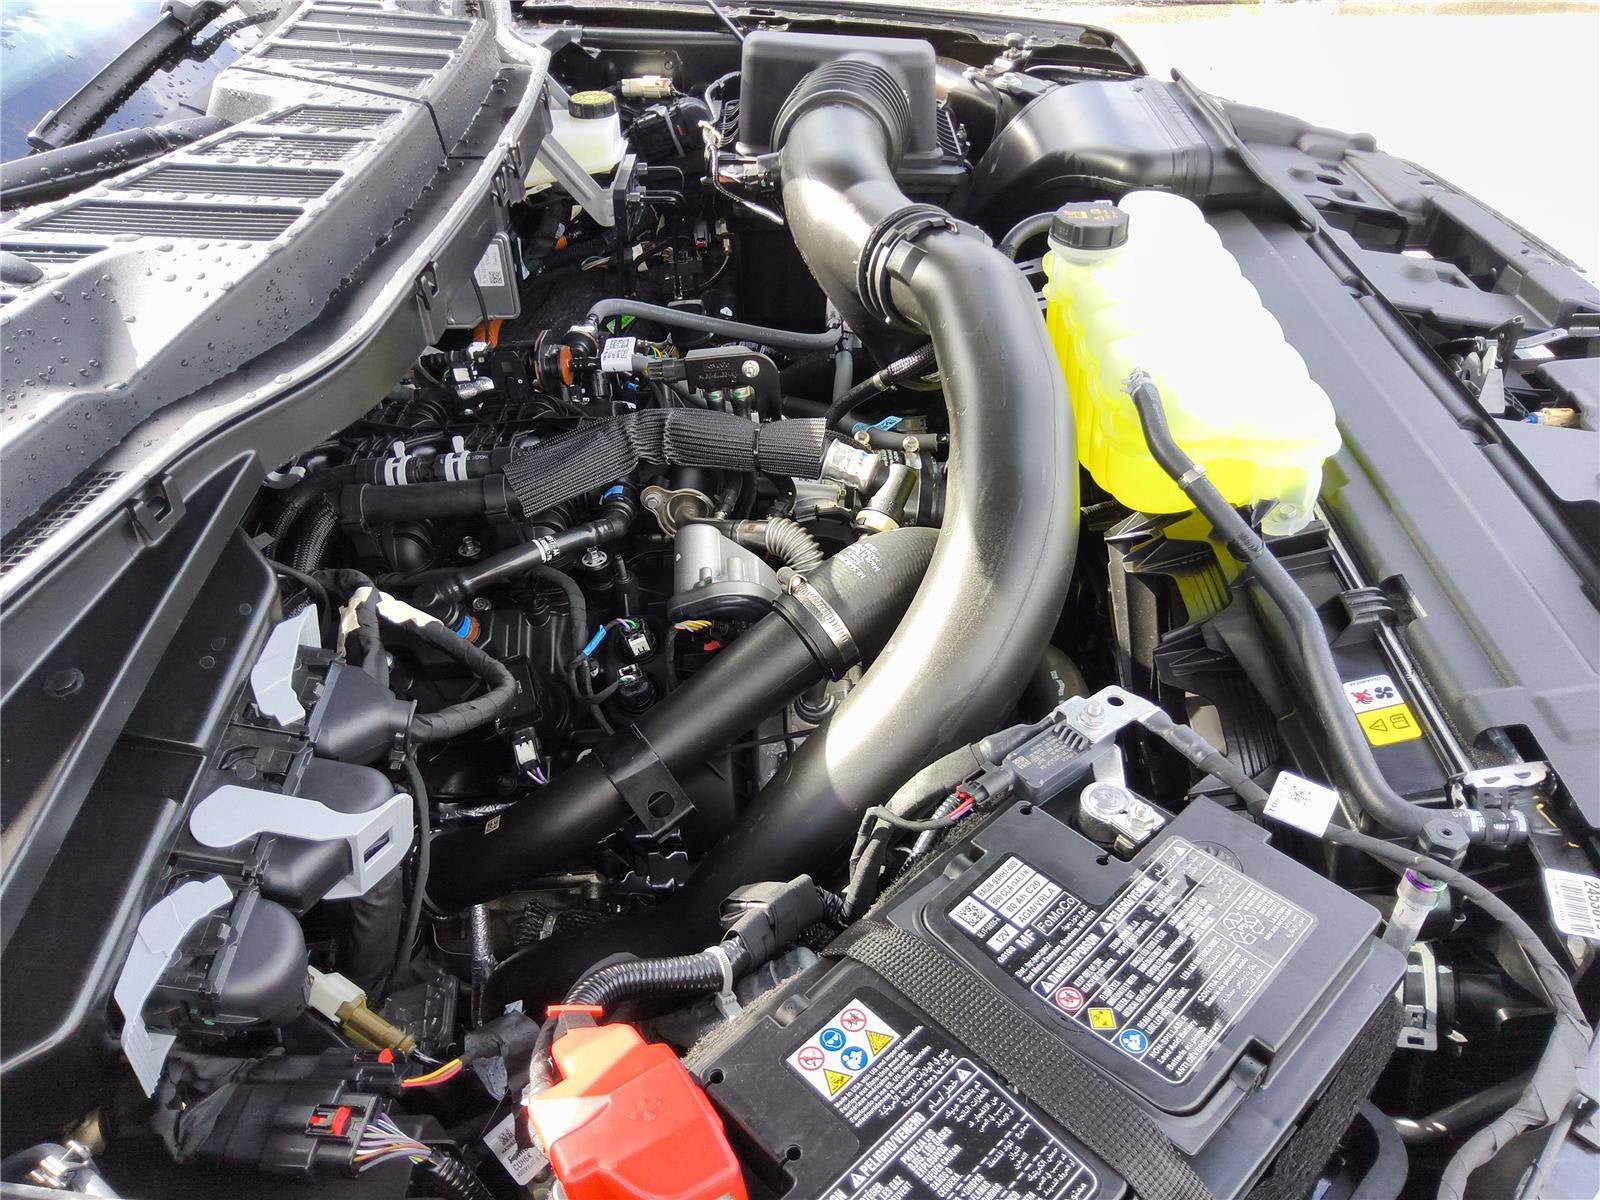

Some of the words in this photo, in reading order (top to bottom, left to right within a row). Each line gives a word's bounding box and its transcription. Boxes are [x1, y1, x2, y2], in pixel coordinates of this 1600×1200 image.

[998, 883, 1015, 897] CCA
[1005, 901, 1019, 912] 80
[1014, 892, 1028, 904] Ah
[1024, 879, 1042, 894] C20
[1016, 887, 1056, 923] AGM/VRLA
[1104, 876, 1155, 924] PELIGRO/VENENO
[1036, 895, 1077, 932] FoMoCo
[994, 929, 1011, 944] 12V
[1014, 928, 1039, 949] MF
[1021, 970, 1036, 982] Ford
[1046, 932, 1101, 984] DANGER/POISON
[1196, 978, 1219, 1002] CONTRA
[1214, 951, 1242, 980] DERRAMES
[1148, 1014, 1188, 1058] NON-SPILLABLE
[1156, 1048, 1173, 1064] Lead
[1167, 1036, 1182, 1051] Acid
[1177, 1018, 1198, 1039] Battery
[1173, 1060, 1190, 1077] ANTI
[1184, 1020, 1222, 1063] DÉVERSEMENT
[1183, 1041, 1194, 1051] au
[1188, 1025, 1207, 1044] plomb
[1166, 1048, 1188, 1071] Batterie
[833, 1094, 848, 1109] Made
[849, 1081, 862, 1093] USA
[859, 1072, 871, 1084] with
[924, 1075, 962, 1113] خطر/سام
[858, 1109, 926, 1177] PELIGRO/VENENO
[899, 1136, 927, 1165] PROTEJA
[921, 1127, 936, 1142] LOS
[921, 1141, 936, 1156] LOS
[931, 1125, 952, 1146] GASES
[914, 1142, 949, 1178] EXPLOSIVOS
[921, 1161, 944, 1185] PUEDEN
[940, 1143, 962, 1166] CAUSAR
[888, 1174, 904, 1191] GAZ
[927, 1169, 949, 1191] DAÑOS
[936, 1169, 963, 1198] CEGUERA.
